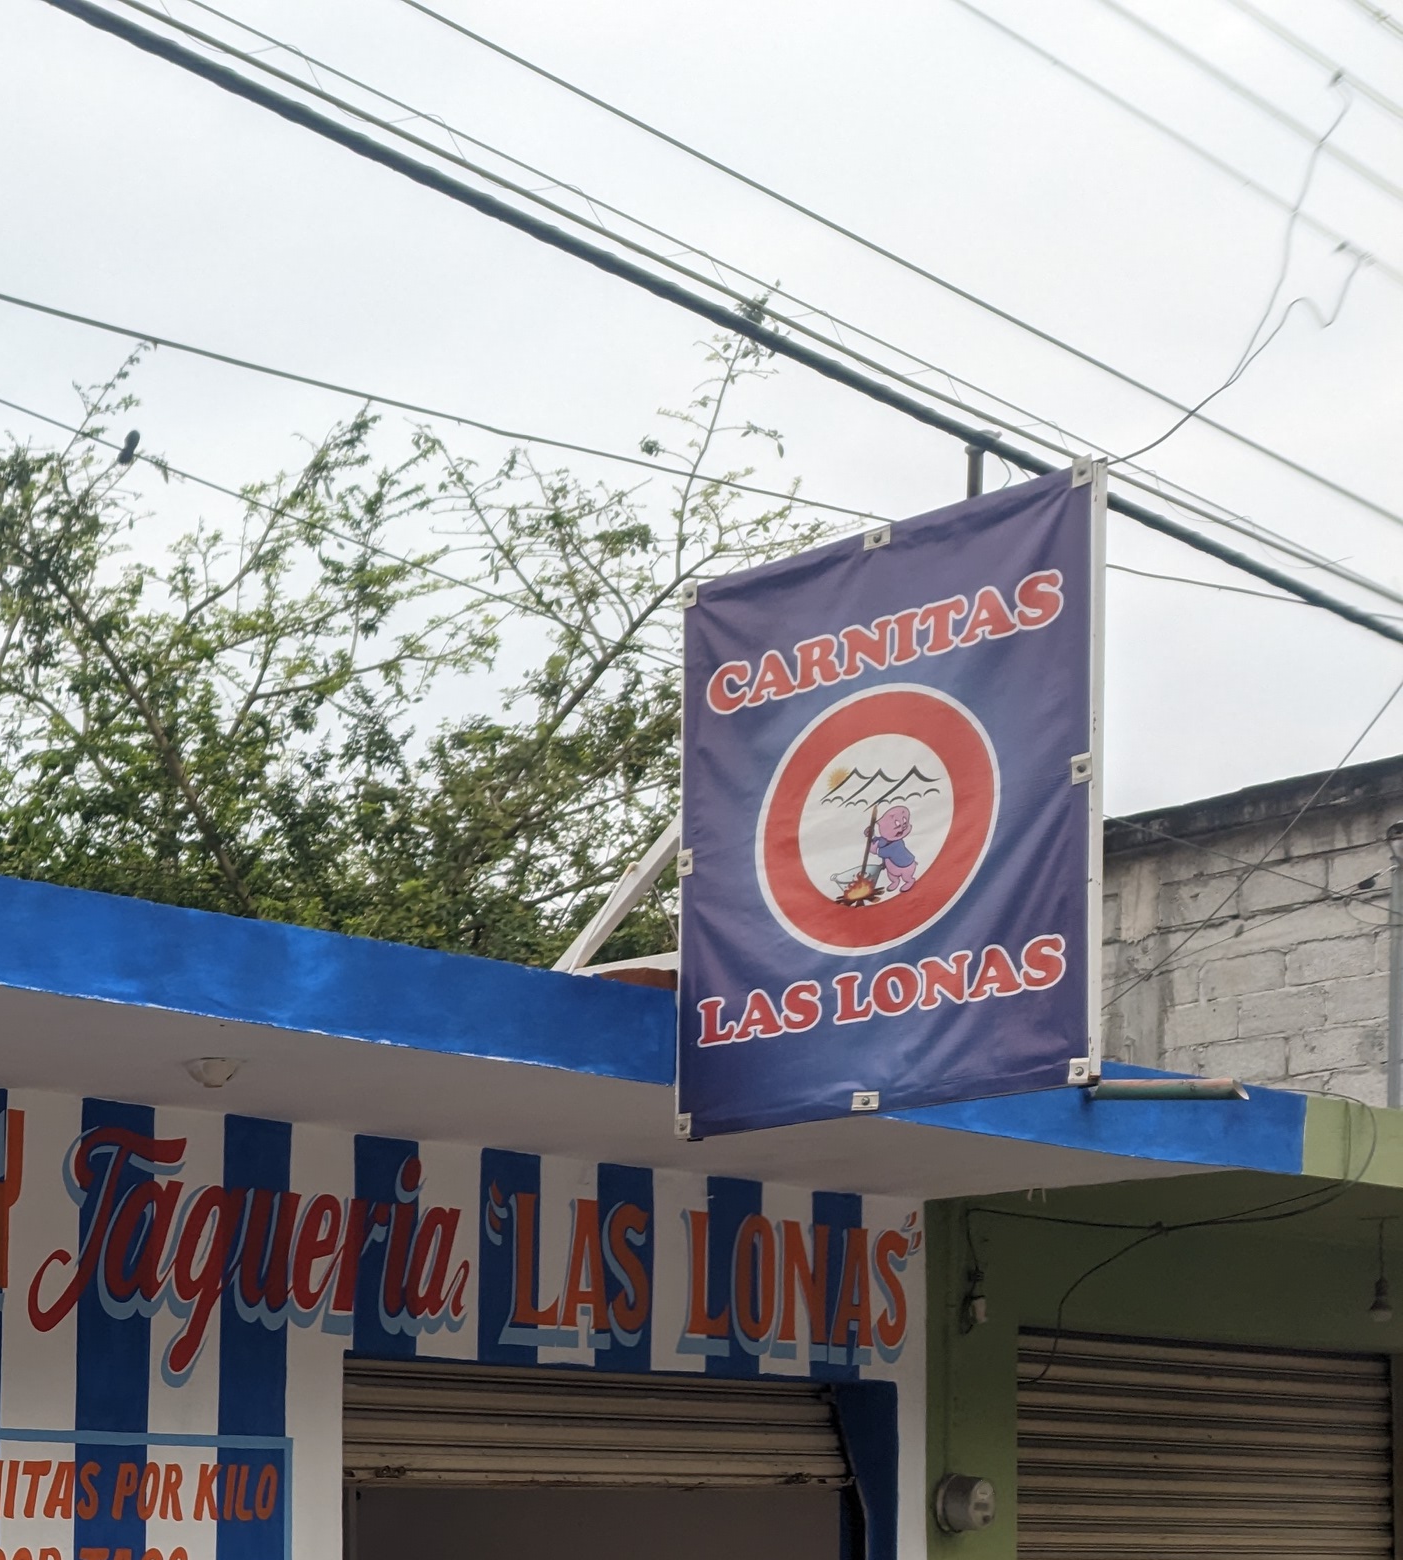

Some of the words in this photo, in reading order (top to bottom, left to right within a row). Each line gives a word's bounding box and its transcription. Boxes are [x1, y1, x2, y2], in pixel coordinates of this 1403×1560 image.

[706, 569, 1064, 715] CARNITAS
[697, 981, 821, 1047] LAS
[834, 934, 1067, 1025] LONAS
[111, 1462, 184, 1521] POR
[193, 1464, 278, 1521] KILO
